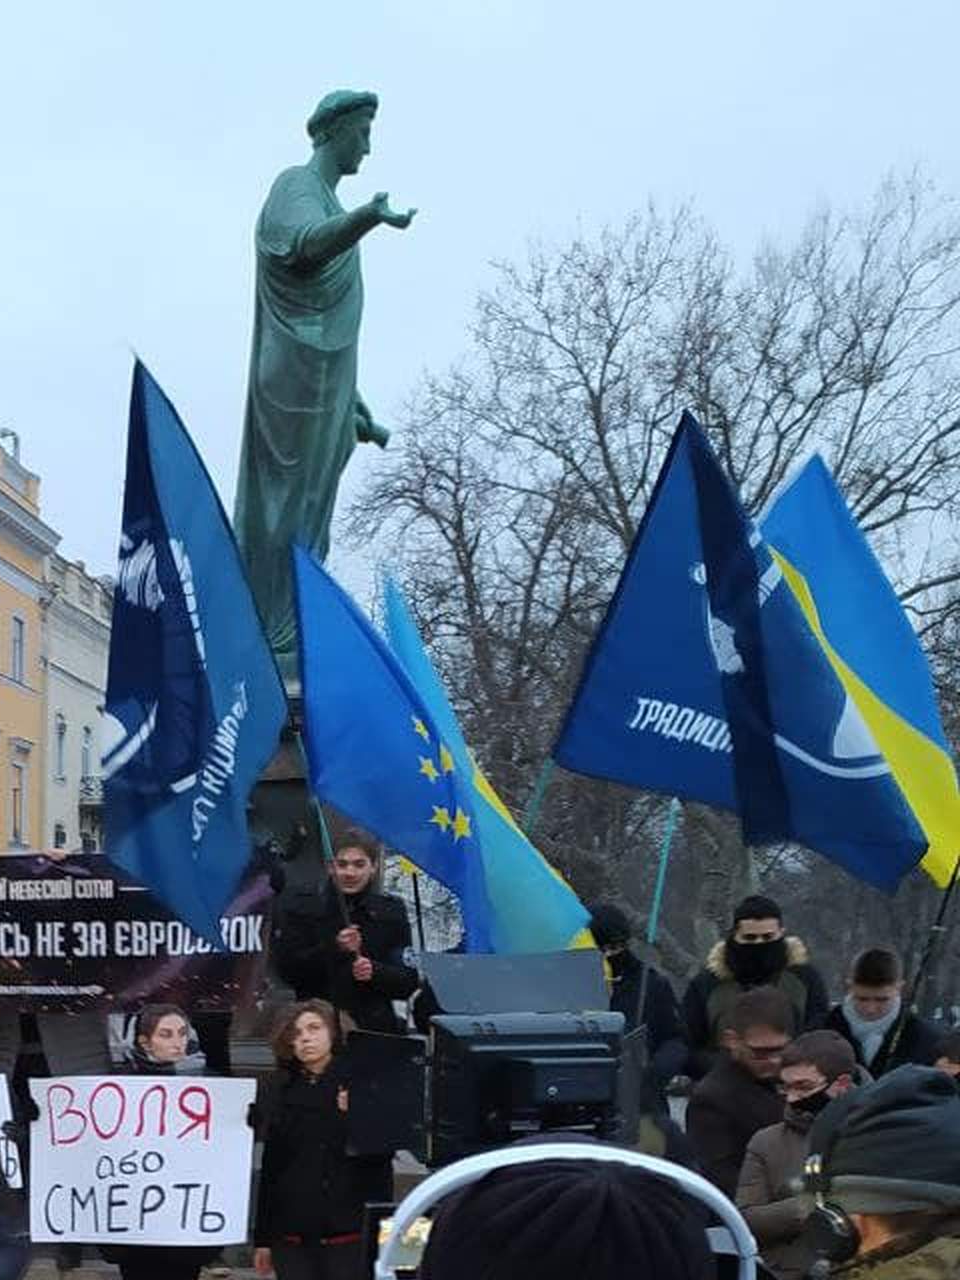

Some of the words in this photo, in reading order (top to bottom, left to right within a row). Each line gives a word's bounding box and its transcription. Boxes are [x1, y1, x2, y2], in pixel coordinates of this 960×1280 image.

[630, 697, 734, 753] ТРАДИЦІ
[36, 921, 65, 957] НЕ
[72, 920, 107, 957] ЗА
[47, 1082, 211, 1146] ВОЛЯ
[96, 1149, 165, 1181] або
[44, 1183, 227, 1236] СМЕРТЬ
